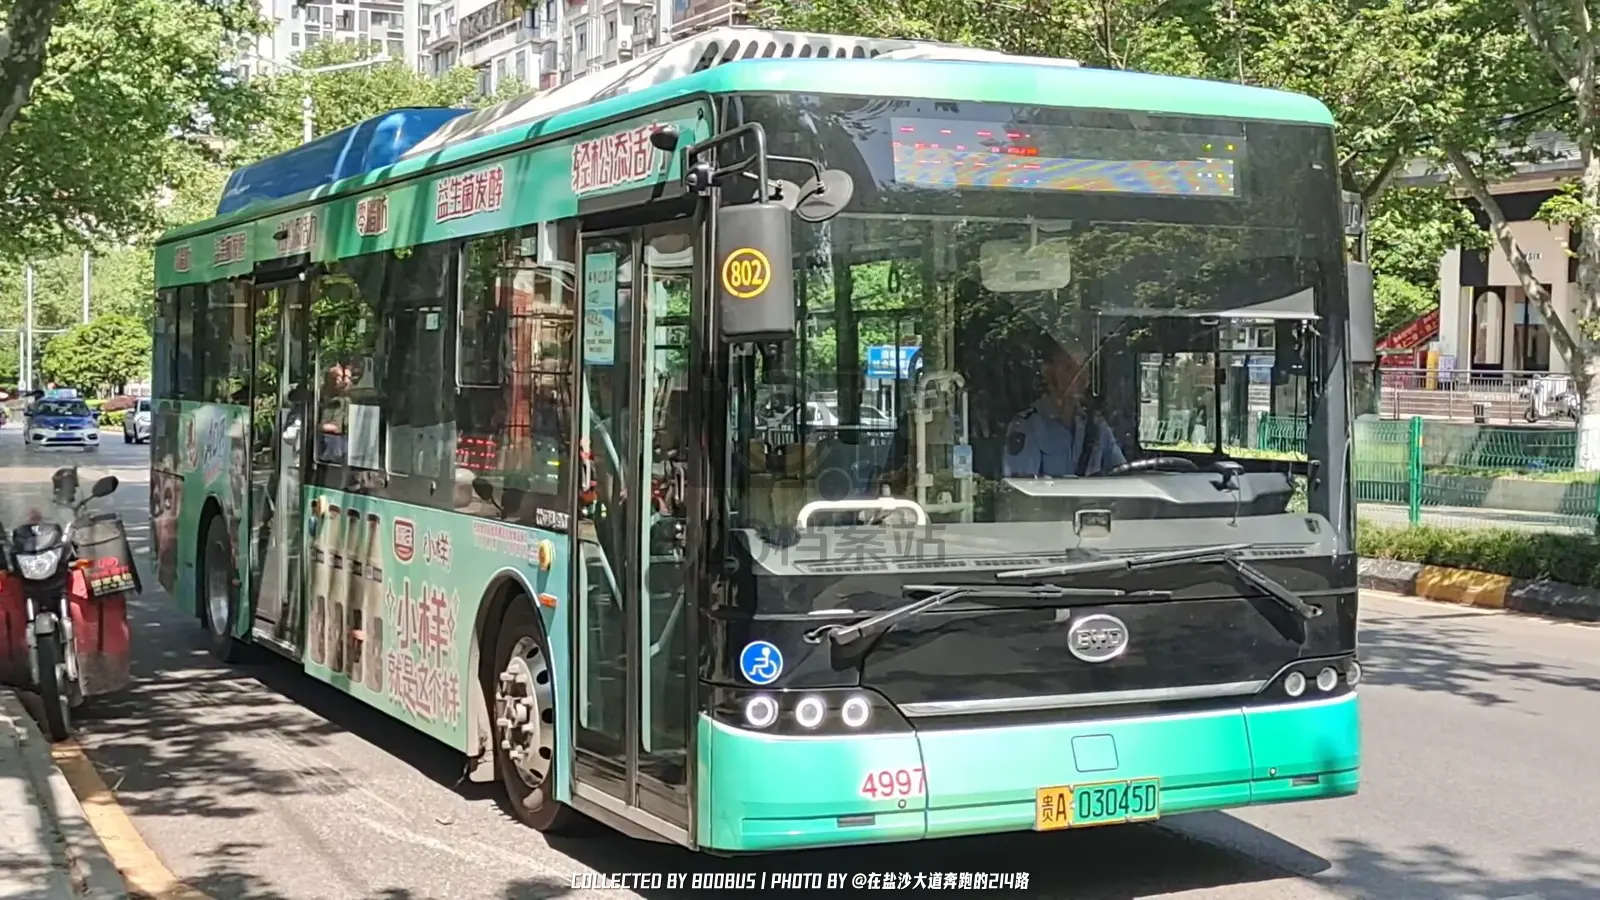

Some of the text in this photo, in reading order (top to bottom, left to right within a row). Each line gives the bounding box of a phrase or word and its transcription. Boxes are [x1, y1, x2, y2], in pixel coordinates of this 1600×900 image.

[437, 166, 504, 220] 益生菌发酵
[731, 259, 763, 287] 802
[397, 580, 449, 668] 小样
[1076, 628, 1121, 650] BYD
[862, 768, 925, 798] 4997
